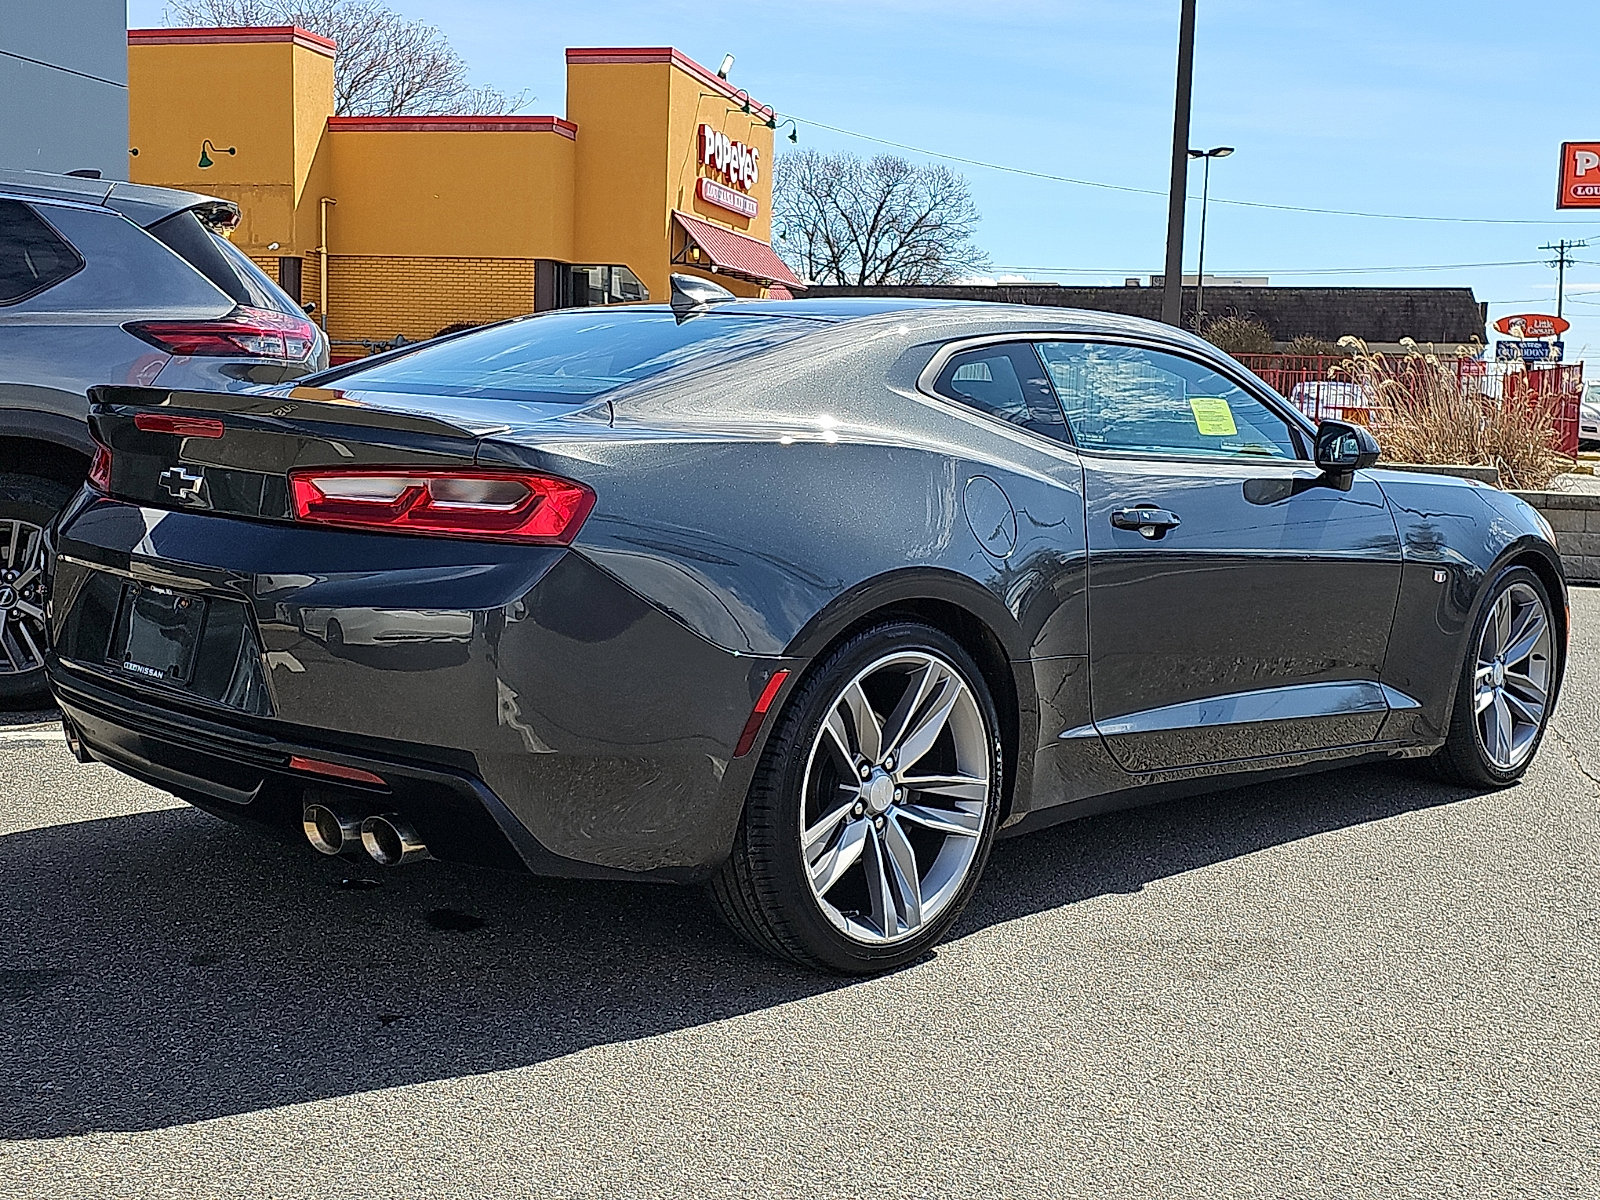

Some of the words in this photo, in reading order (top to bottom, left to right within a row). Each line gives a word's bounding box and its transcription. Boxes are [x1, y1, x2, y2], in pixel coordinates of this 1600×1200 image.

[1575, 150, 1600, 176] P
[1533, 319, 1554, 329] Little
[1527, 326, 1556, 335] Caesars
